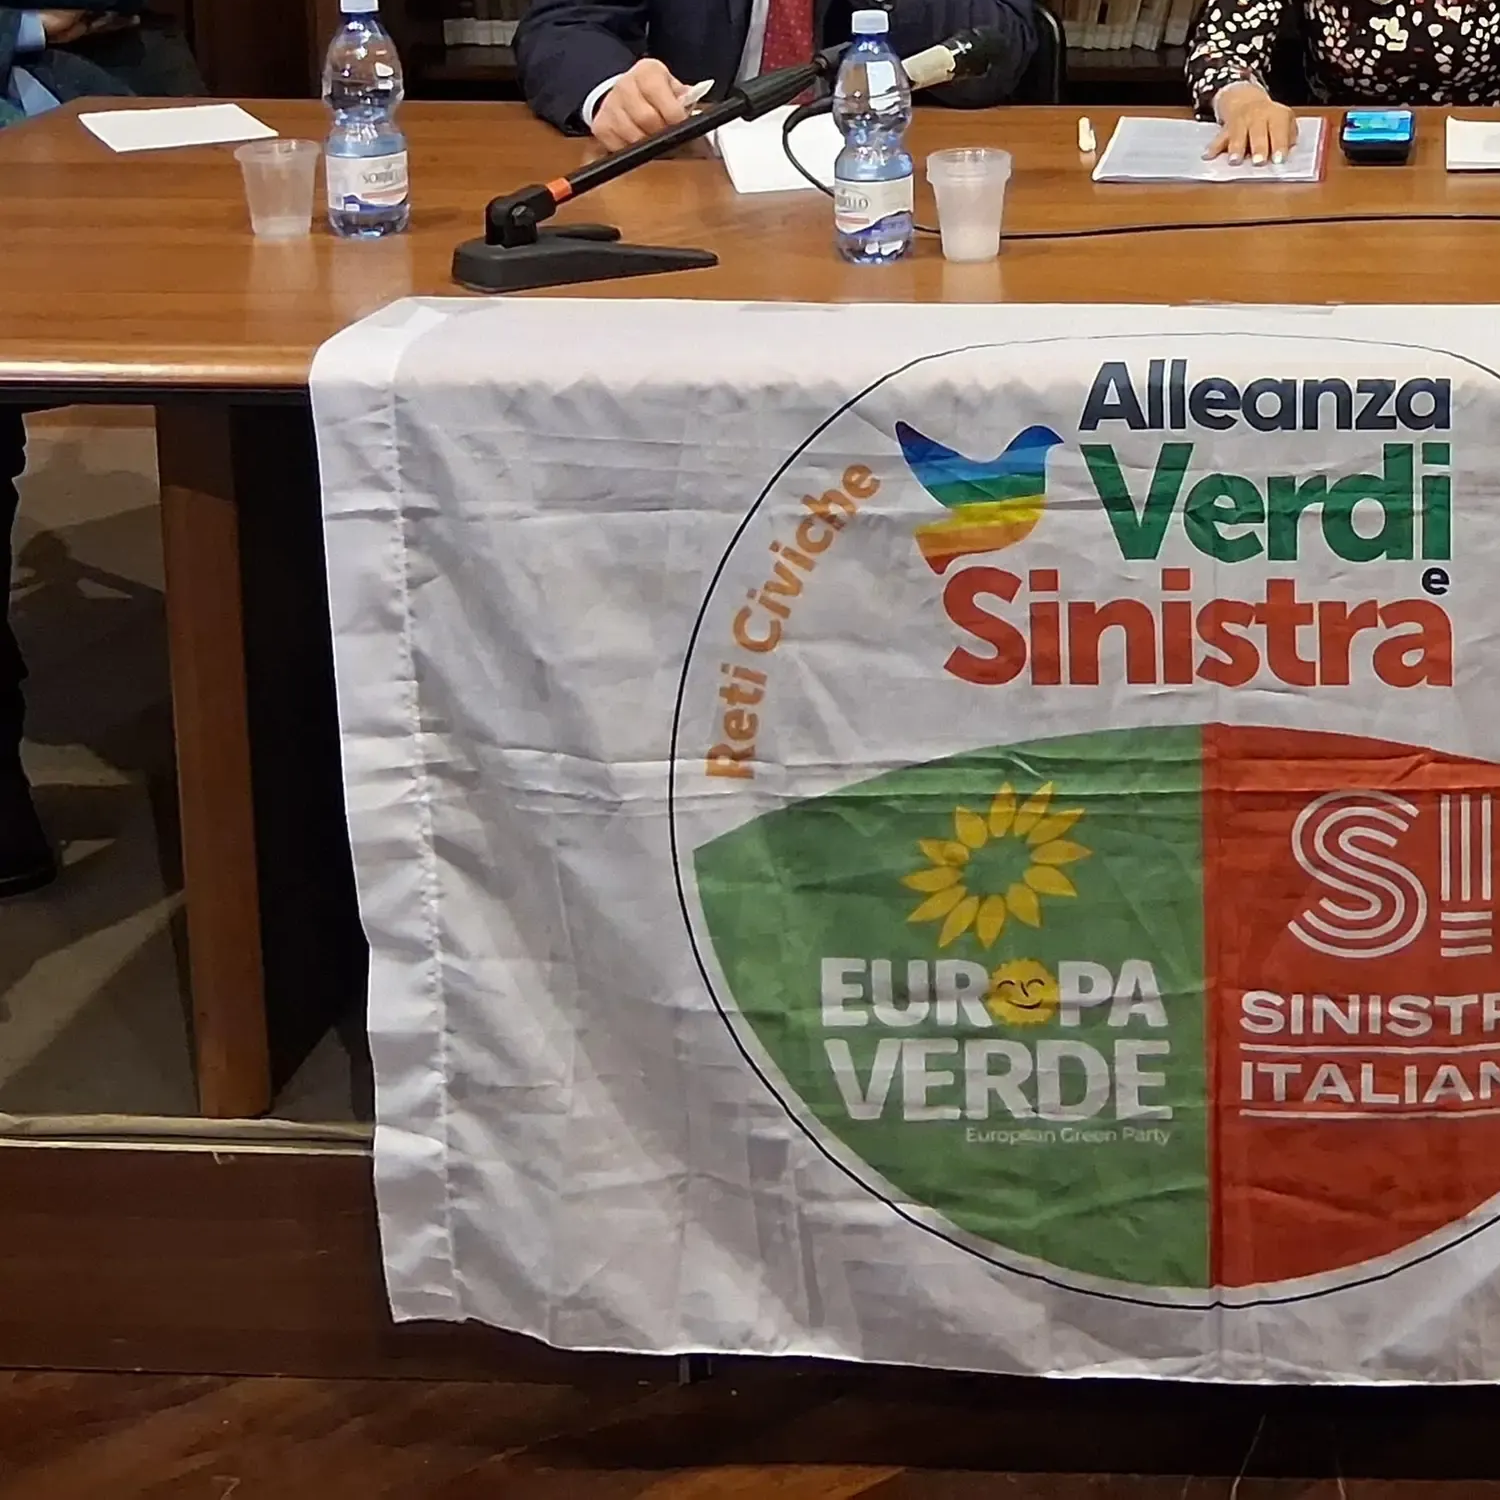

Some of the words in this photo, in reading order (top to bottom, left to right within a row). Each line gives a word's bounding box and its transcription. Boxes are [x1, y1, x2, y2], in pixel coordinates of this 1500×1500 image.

[1079, 359, 1452, 431] Alleanza
[1079, 442, 1452, 561] Verdi
[730, 463, 882, 653] Civiche
[1422, 567, 1449, 596] e
[942, 566, 1453, 687] Sinistra
[704, 662, 767, 781] Reti
[823, 1037, 1173, 1123] VERDE
[965, 1127, 1056, 1145] European
[1060, 1127, 1117, 1143] Green
[1123, 1127, 1171, 1146] Party
